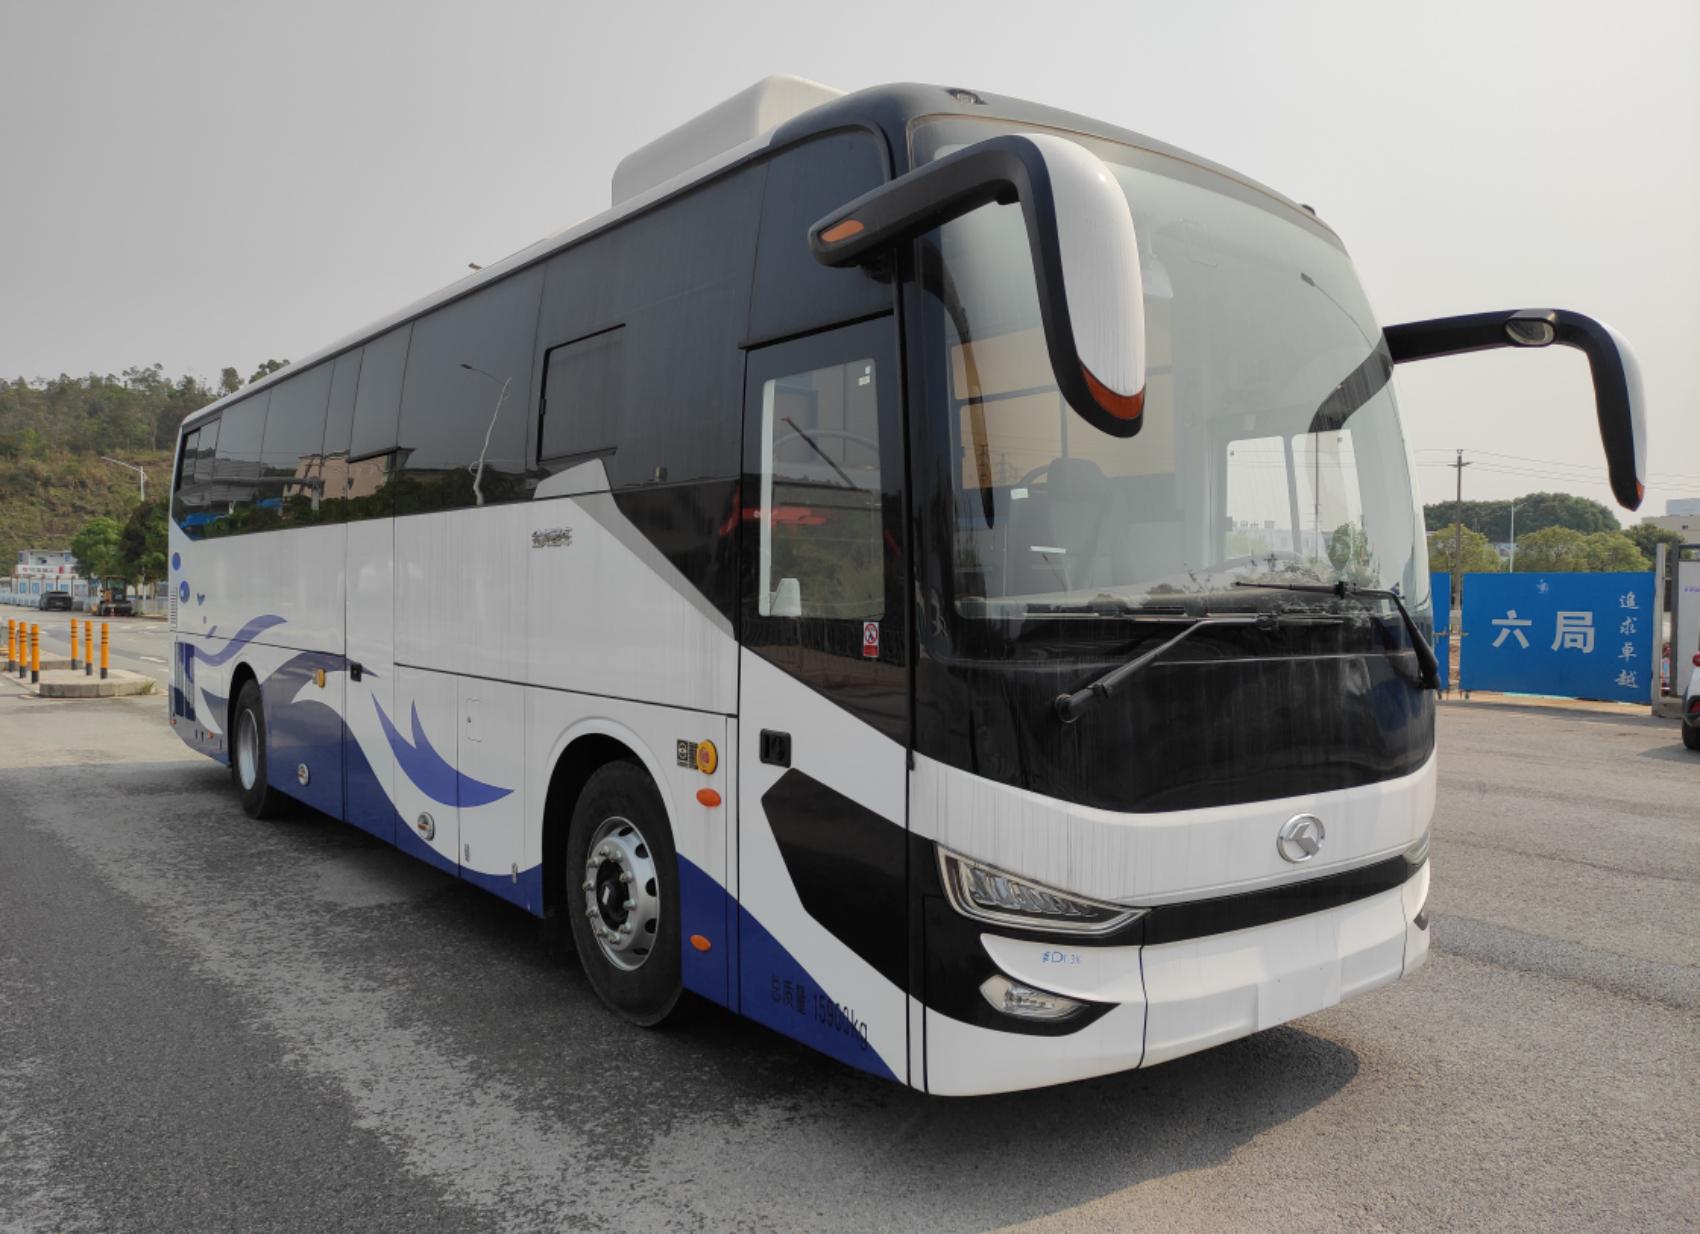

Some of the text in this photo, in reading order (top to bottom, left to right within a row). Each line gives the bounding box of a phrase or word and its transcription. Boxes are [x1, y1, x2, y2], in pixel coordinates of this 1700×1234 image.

[1491, 609, 1595, 654] 六局
[1614, 591, 1640, 689] 追求卓越
